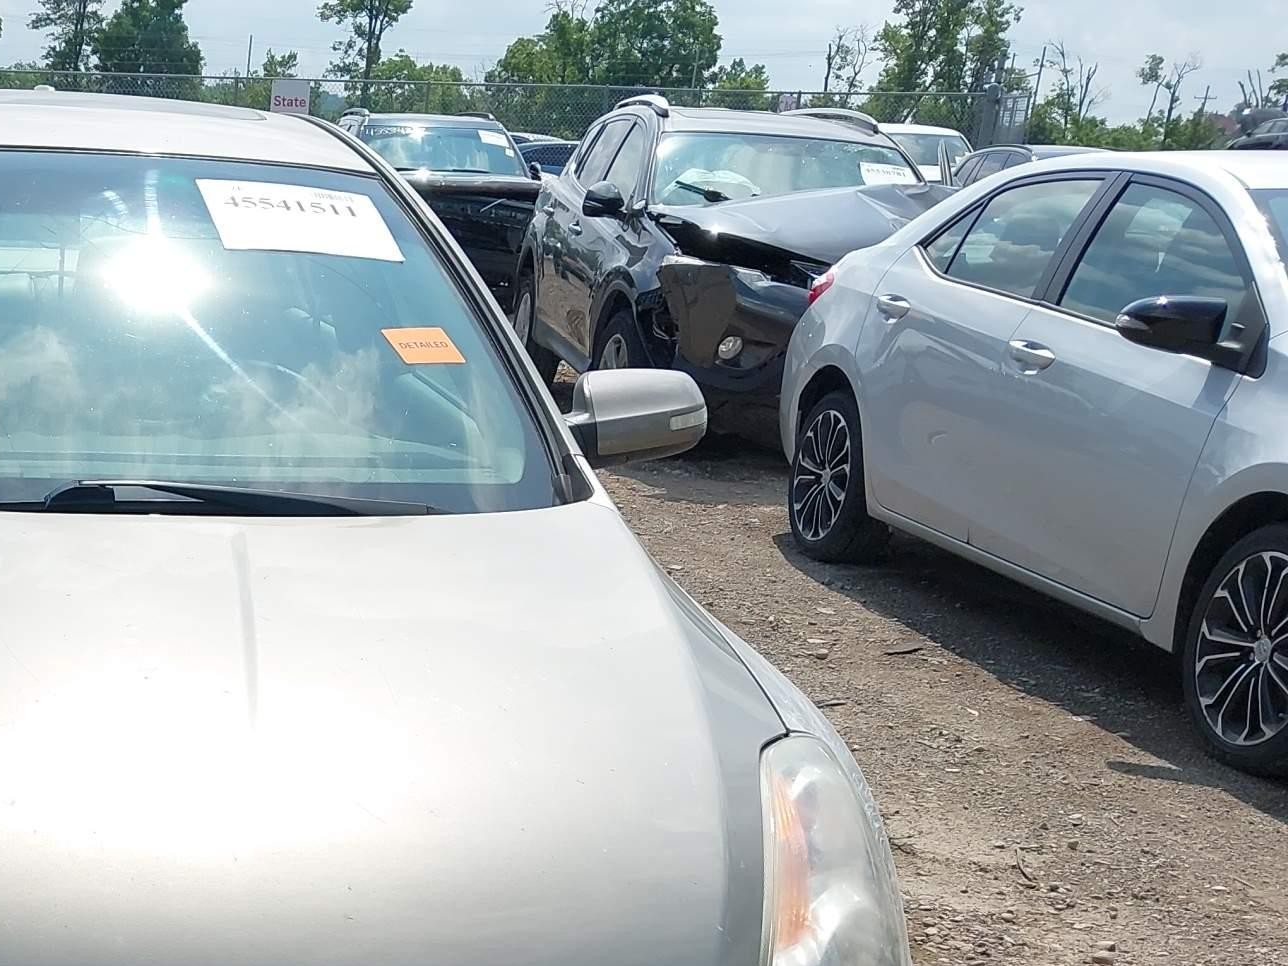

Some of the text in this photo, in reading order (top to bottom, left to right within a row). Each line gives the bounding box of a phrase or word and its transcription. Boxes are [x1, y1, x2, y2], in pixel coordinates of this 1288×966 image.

[273, 95, 307, 107] State
[224, 195, 357, 217] 45541511
[398, 341, 449, 350] DETAILED
